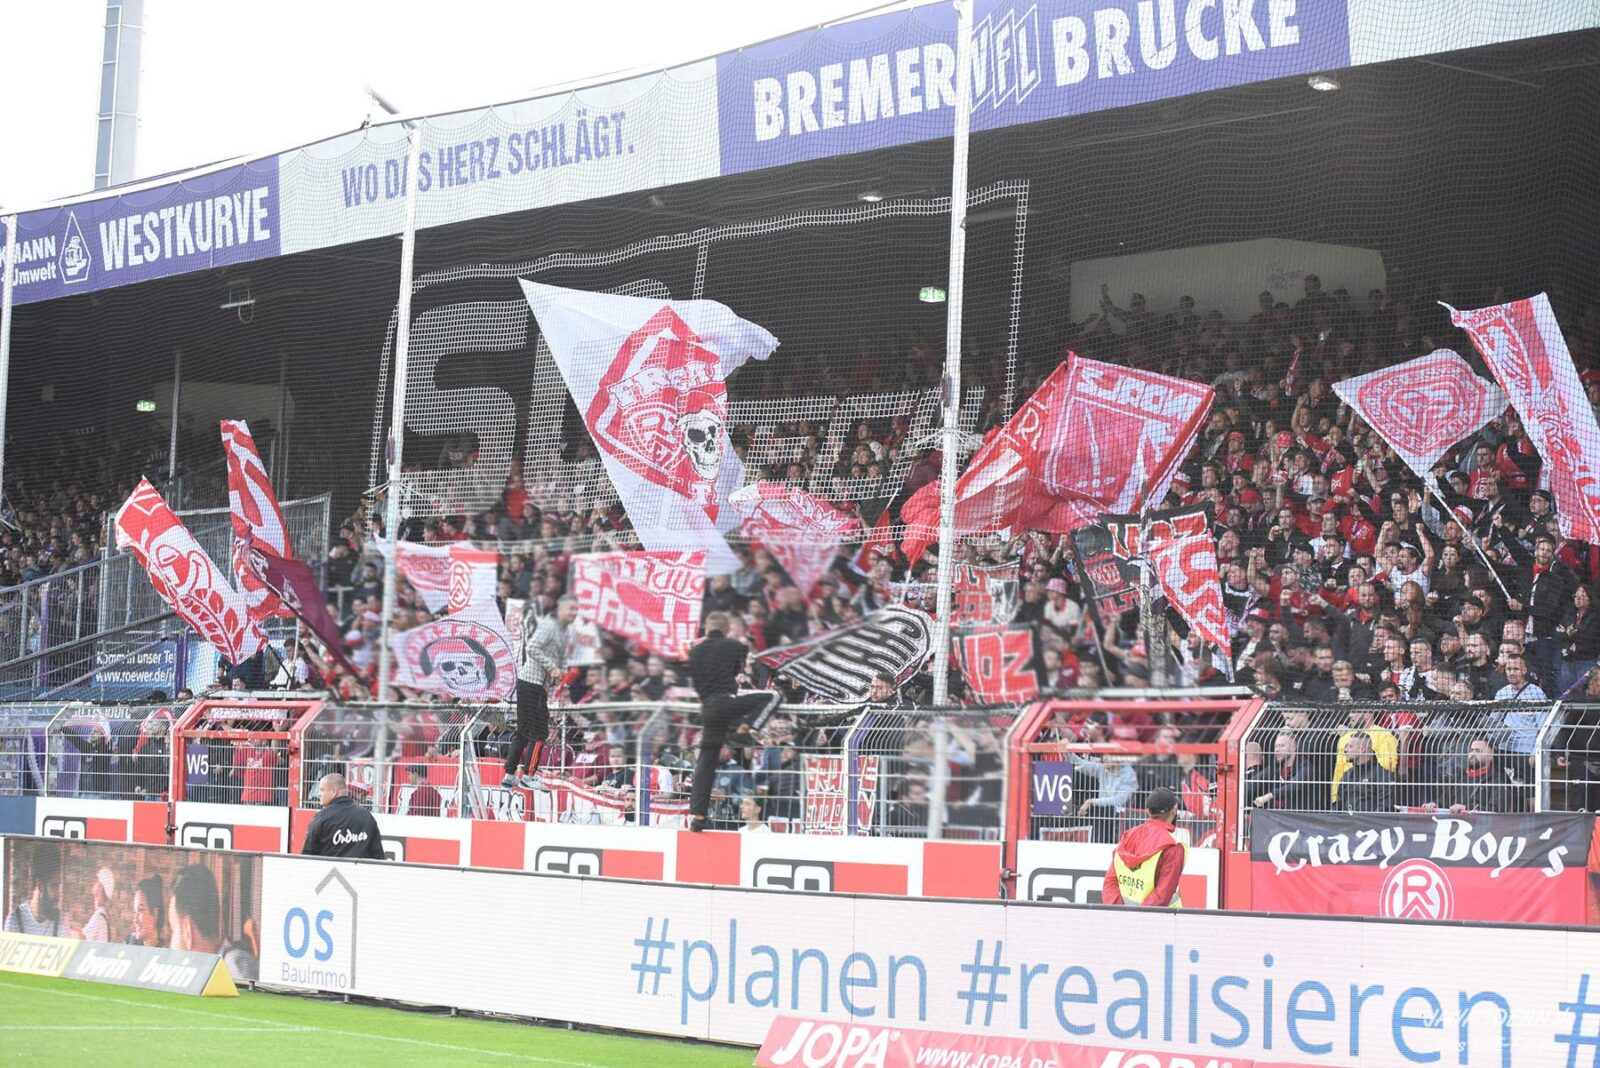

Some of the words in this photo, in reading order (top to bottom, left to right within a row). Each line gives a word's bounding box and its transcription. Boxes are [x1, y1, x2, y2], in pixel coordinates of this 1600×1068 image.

[753, 42, 957, 142] BREMER
[342, 163, 378, 208] WO
[439, 137, 500, 189] HERZ
[507, 108, 634, 175] SCHLÄGT.
[99, 187, 271, 271] WESTKURVE
[137, 654, 161, 664] unser
[186, 754, 209, 775] W5
[1033, 774, 1073, 802] W6
[332, 829, 368, 845] Ordner
[283, 907, 334, 961] OS
[75, 947, 132, 980] bwin
[138, 955, 198, 987] bwin
[630, 916, 927, 1025] #planen
[956, 939, 1511, 1068] #realisieren
